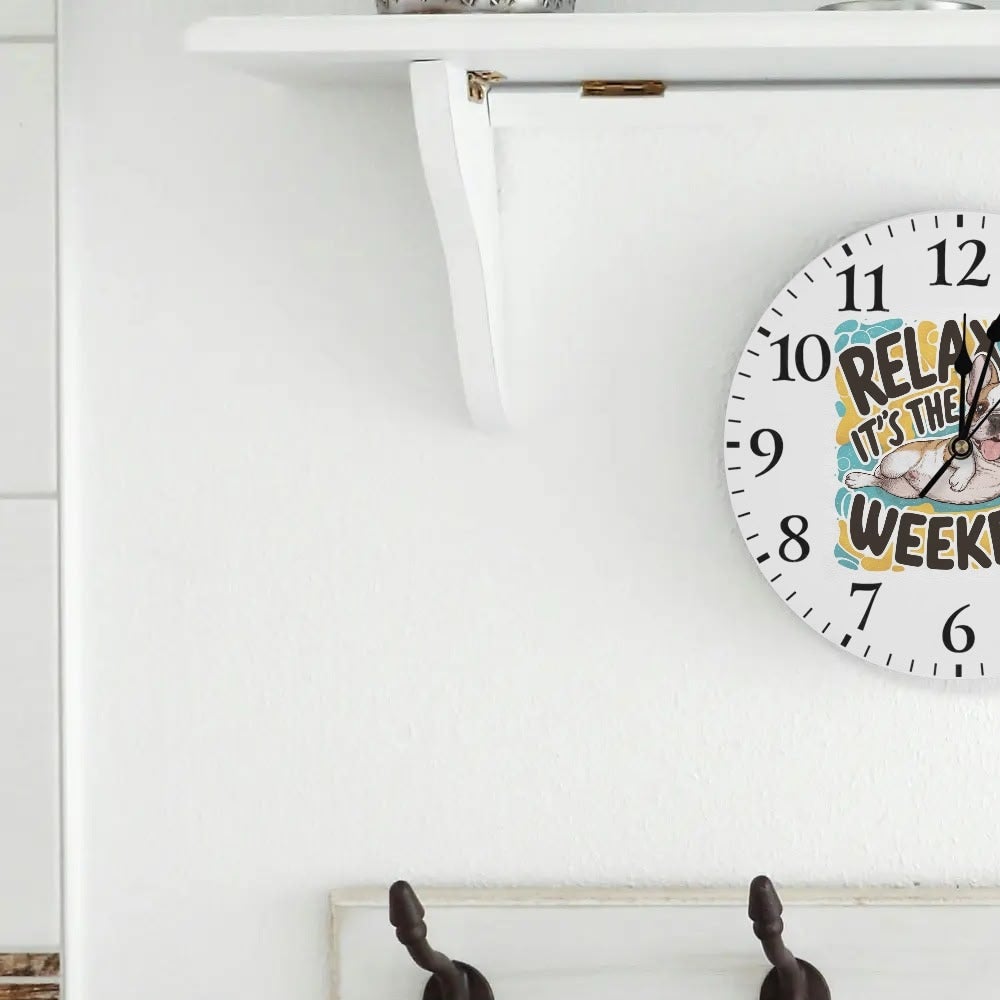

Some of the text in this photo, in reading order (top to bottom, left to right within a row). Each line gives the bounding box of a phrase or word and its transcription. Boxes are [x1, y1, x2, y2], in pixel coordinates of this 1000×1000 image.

[927, 238, 991, 287] 12
[836, 264, 890, 313] 11
[769, 333, 832, 383] 10
[905, 388, 961, 435] THE
[749, 428, 784, 478] 9
[778, 514, 811, 563] 8
[849, 582, 883, 631] 7
[941, 603, 976, 654] 6
